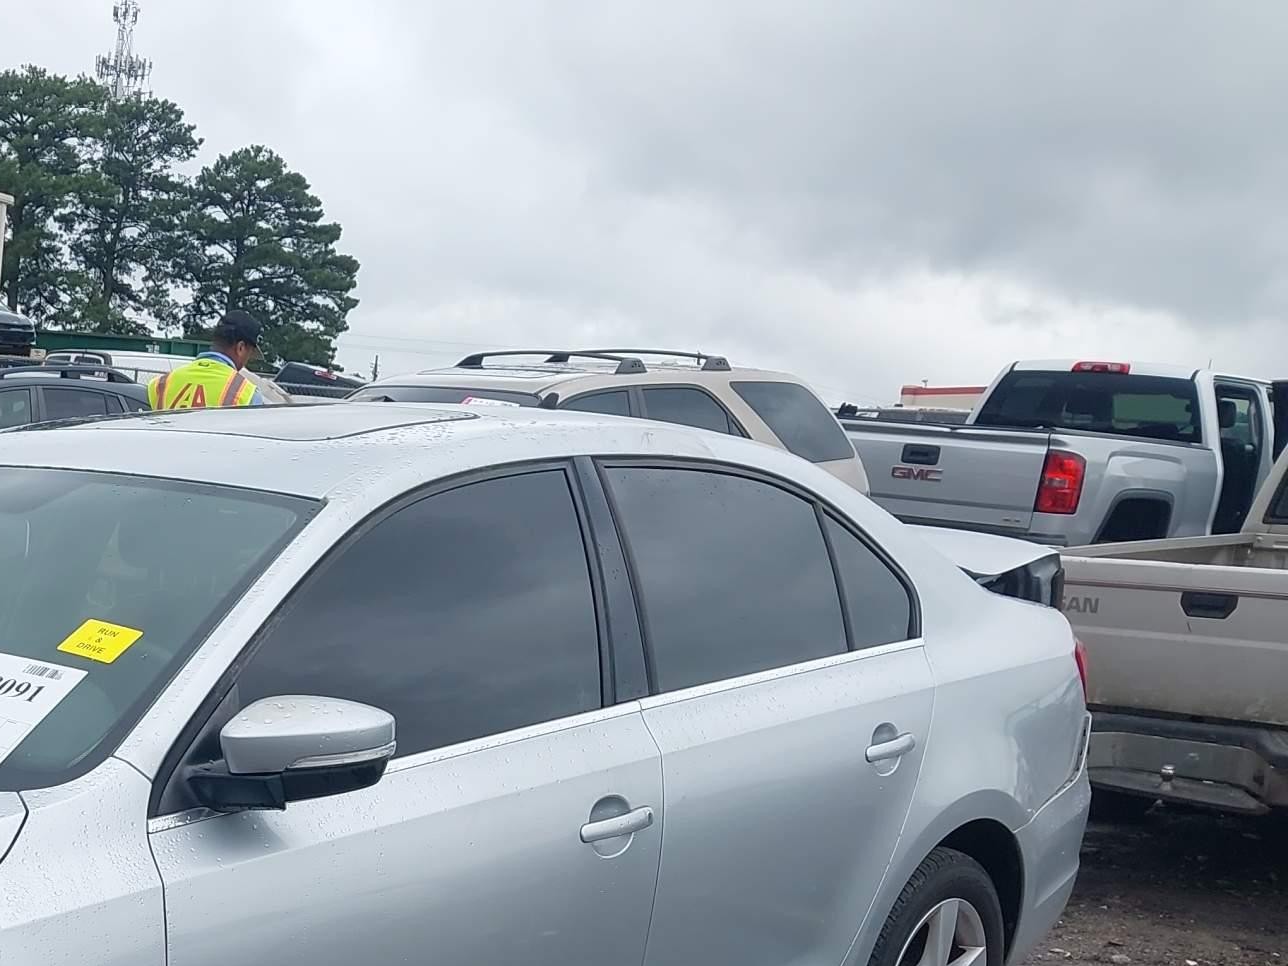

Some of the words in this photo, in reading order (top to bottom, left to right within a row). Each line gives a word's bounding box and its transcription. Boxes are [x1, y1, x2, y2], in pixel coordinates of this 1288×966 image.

[891, 465, 943, 482] GMC
[1063, 596, 1100, 614] AN
[97, 627, 120, 638] RUN
[94, 636, 103, 644] &
[76, 642, 106, 654] DRIVE
